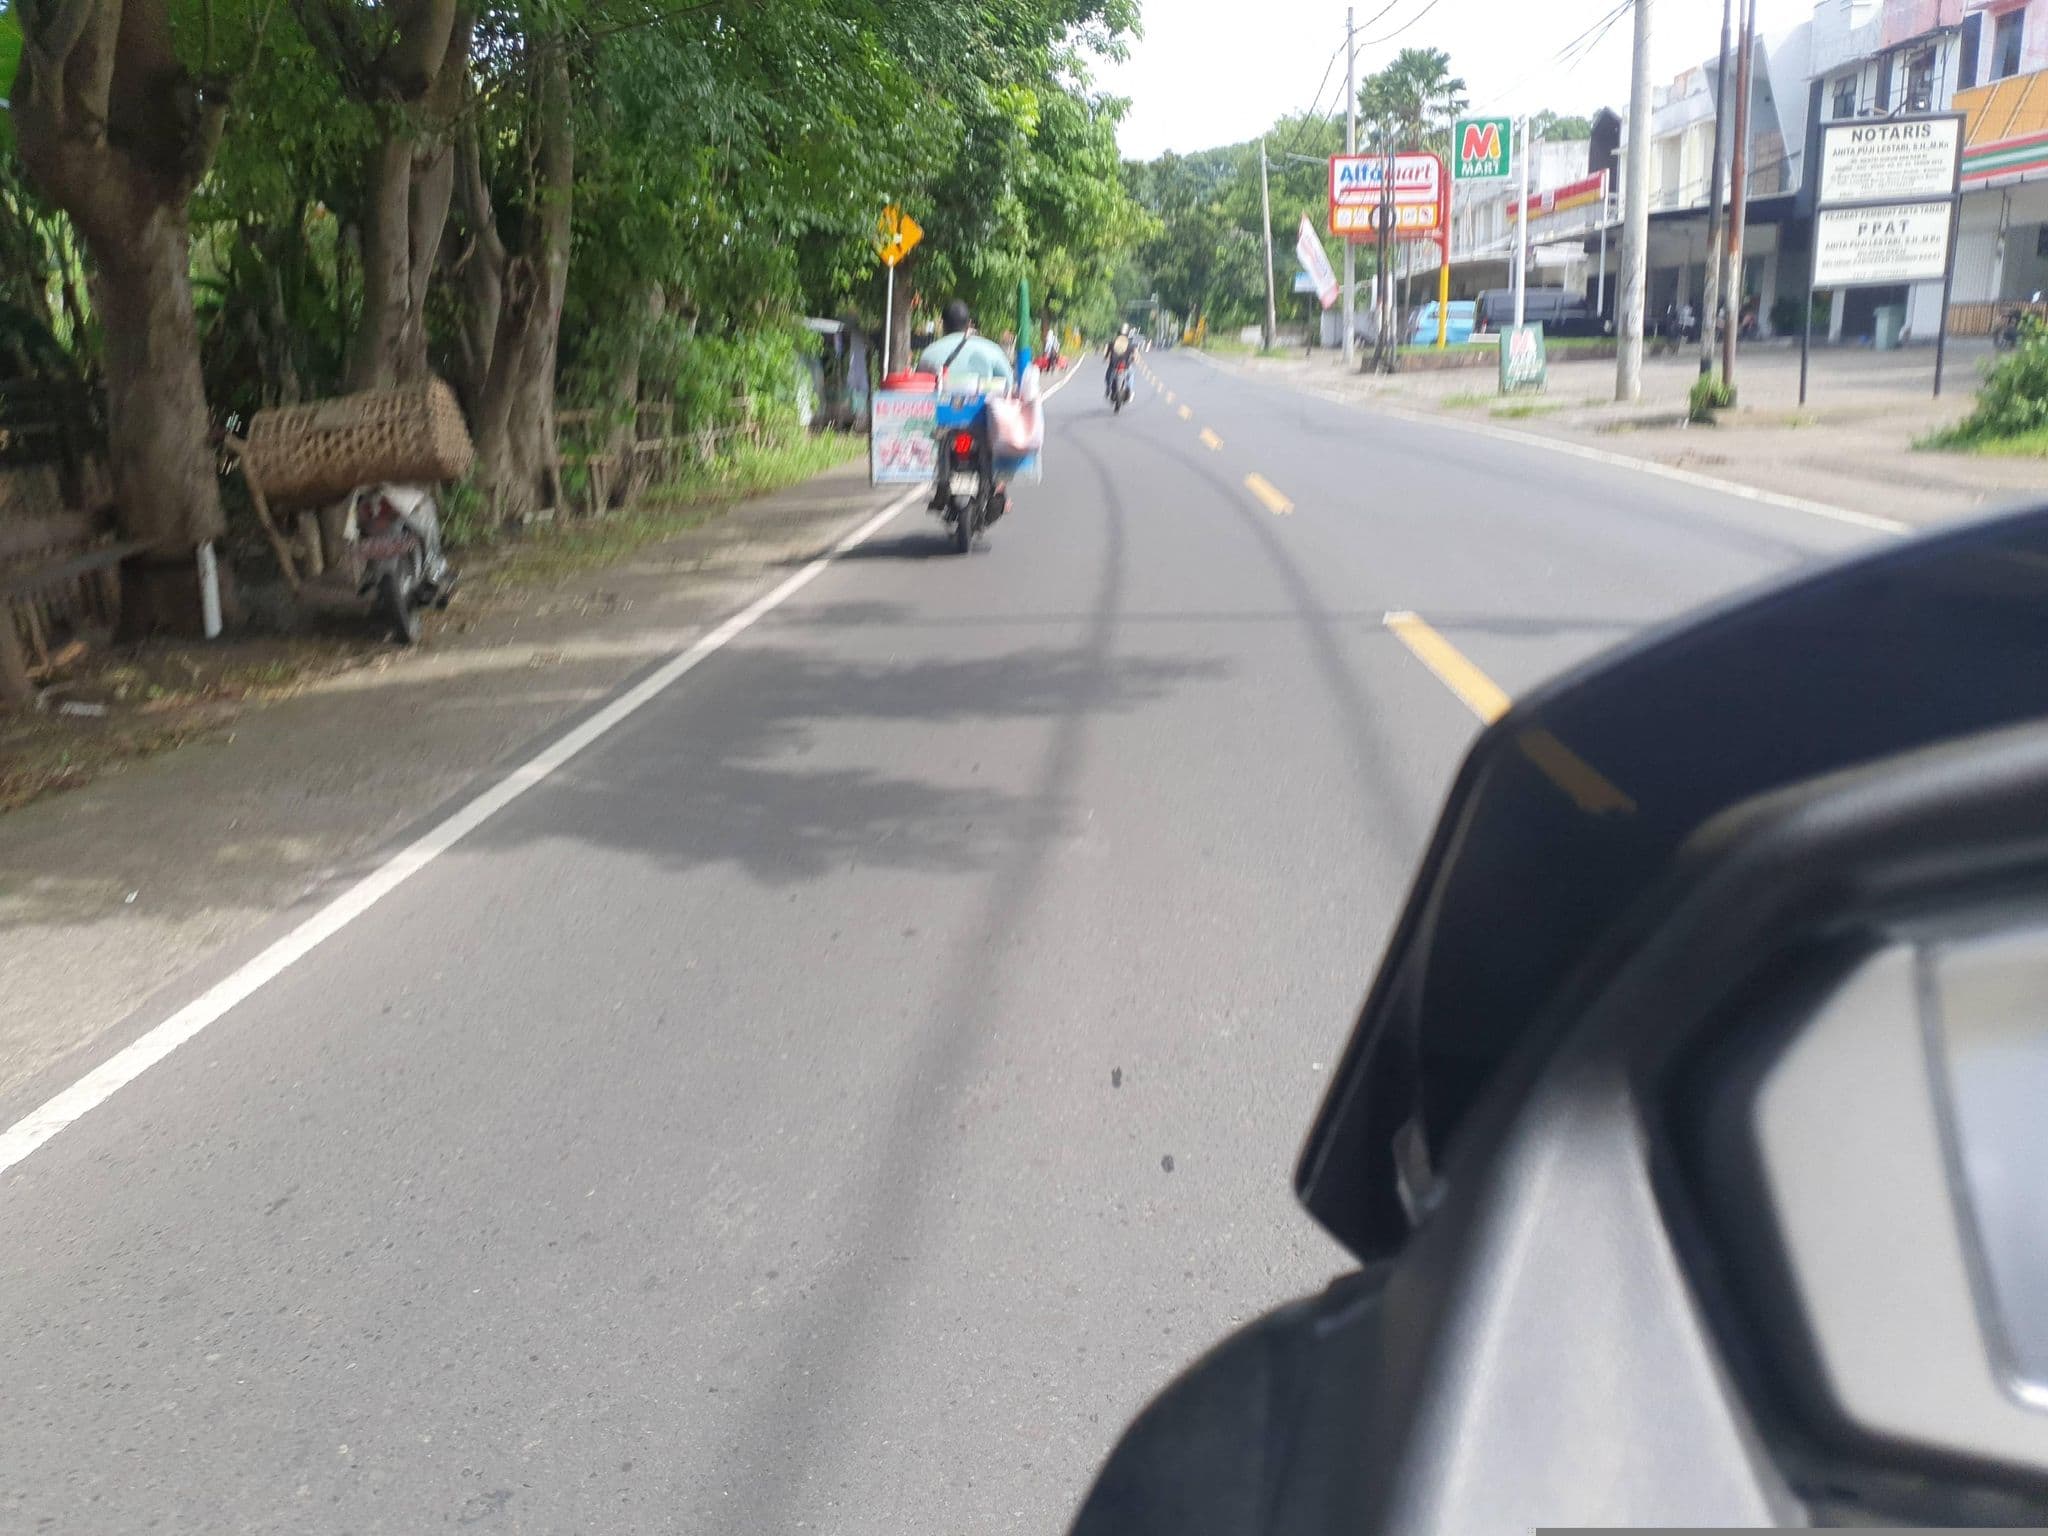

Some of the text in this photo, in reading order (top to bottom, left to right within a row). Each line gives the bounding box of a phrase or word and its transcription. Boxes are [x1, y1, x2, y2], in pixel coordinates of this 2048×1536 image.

[1852, 123, 1931, 142] NOTARIS
[1340, 163, 1431, 182] Alfamart
[1461, 160, 1499, 177] MART
[1858, 219, 1909, 236] PPAT
